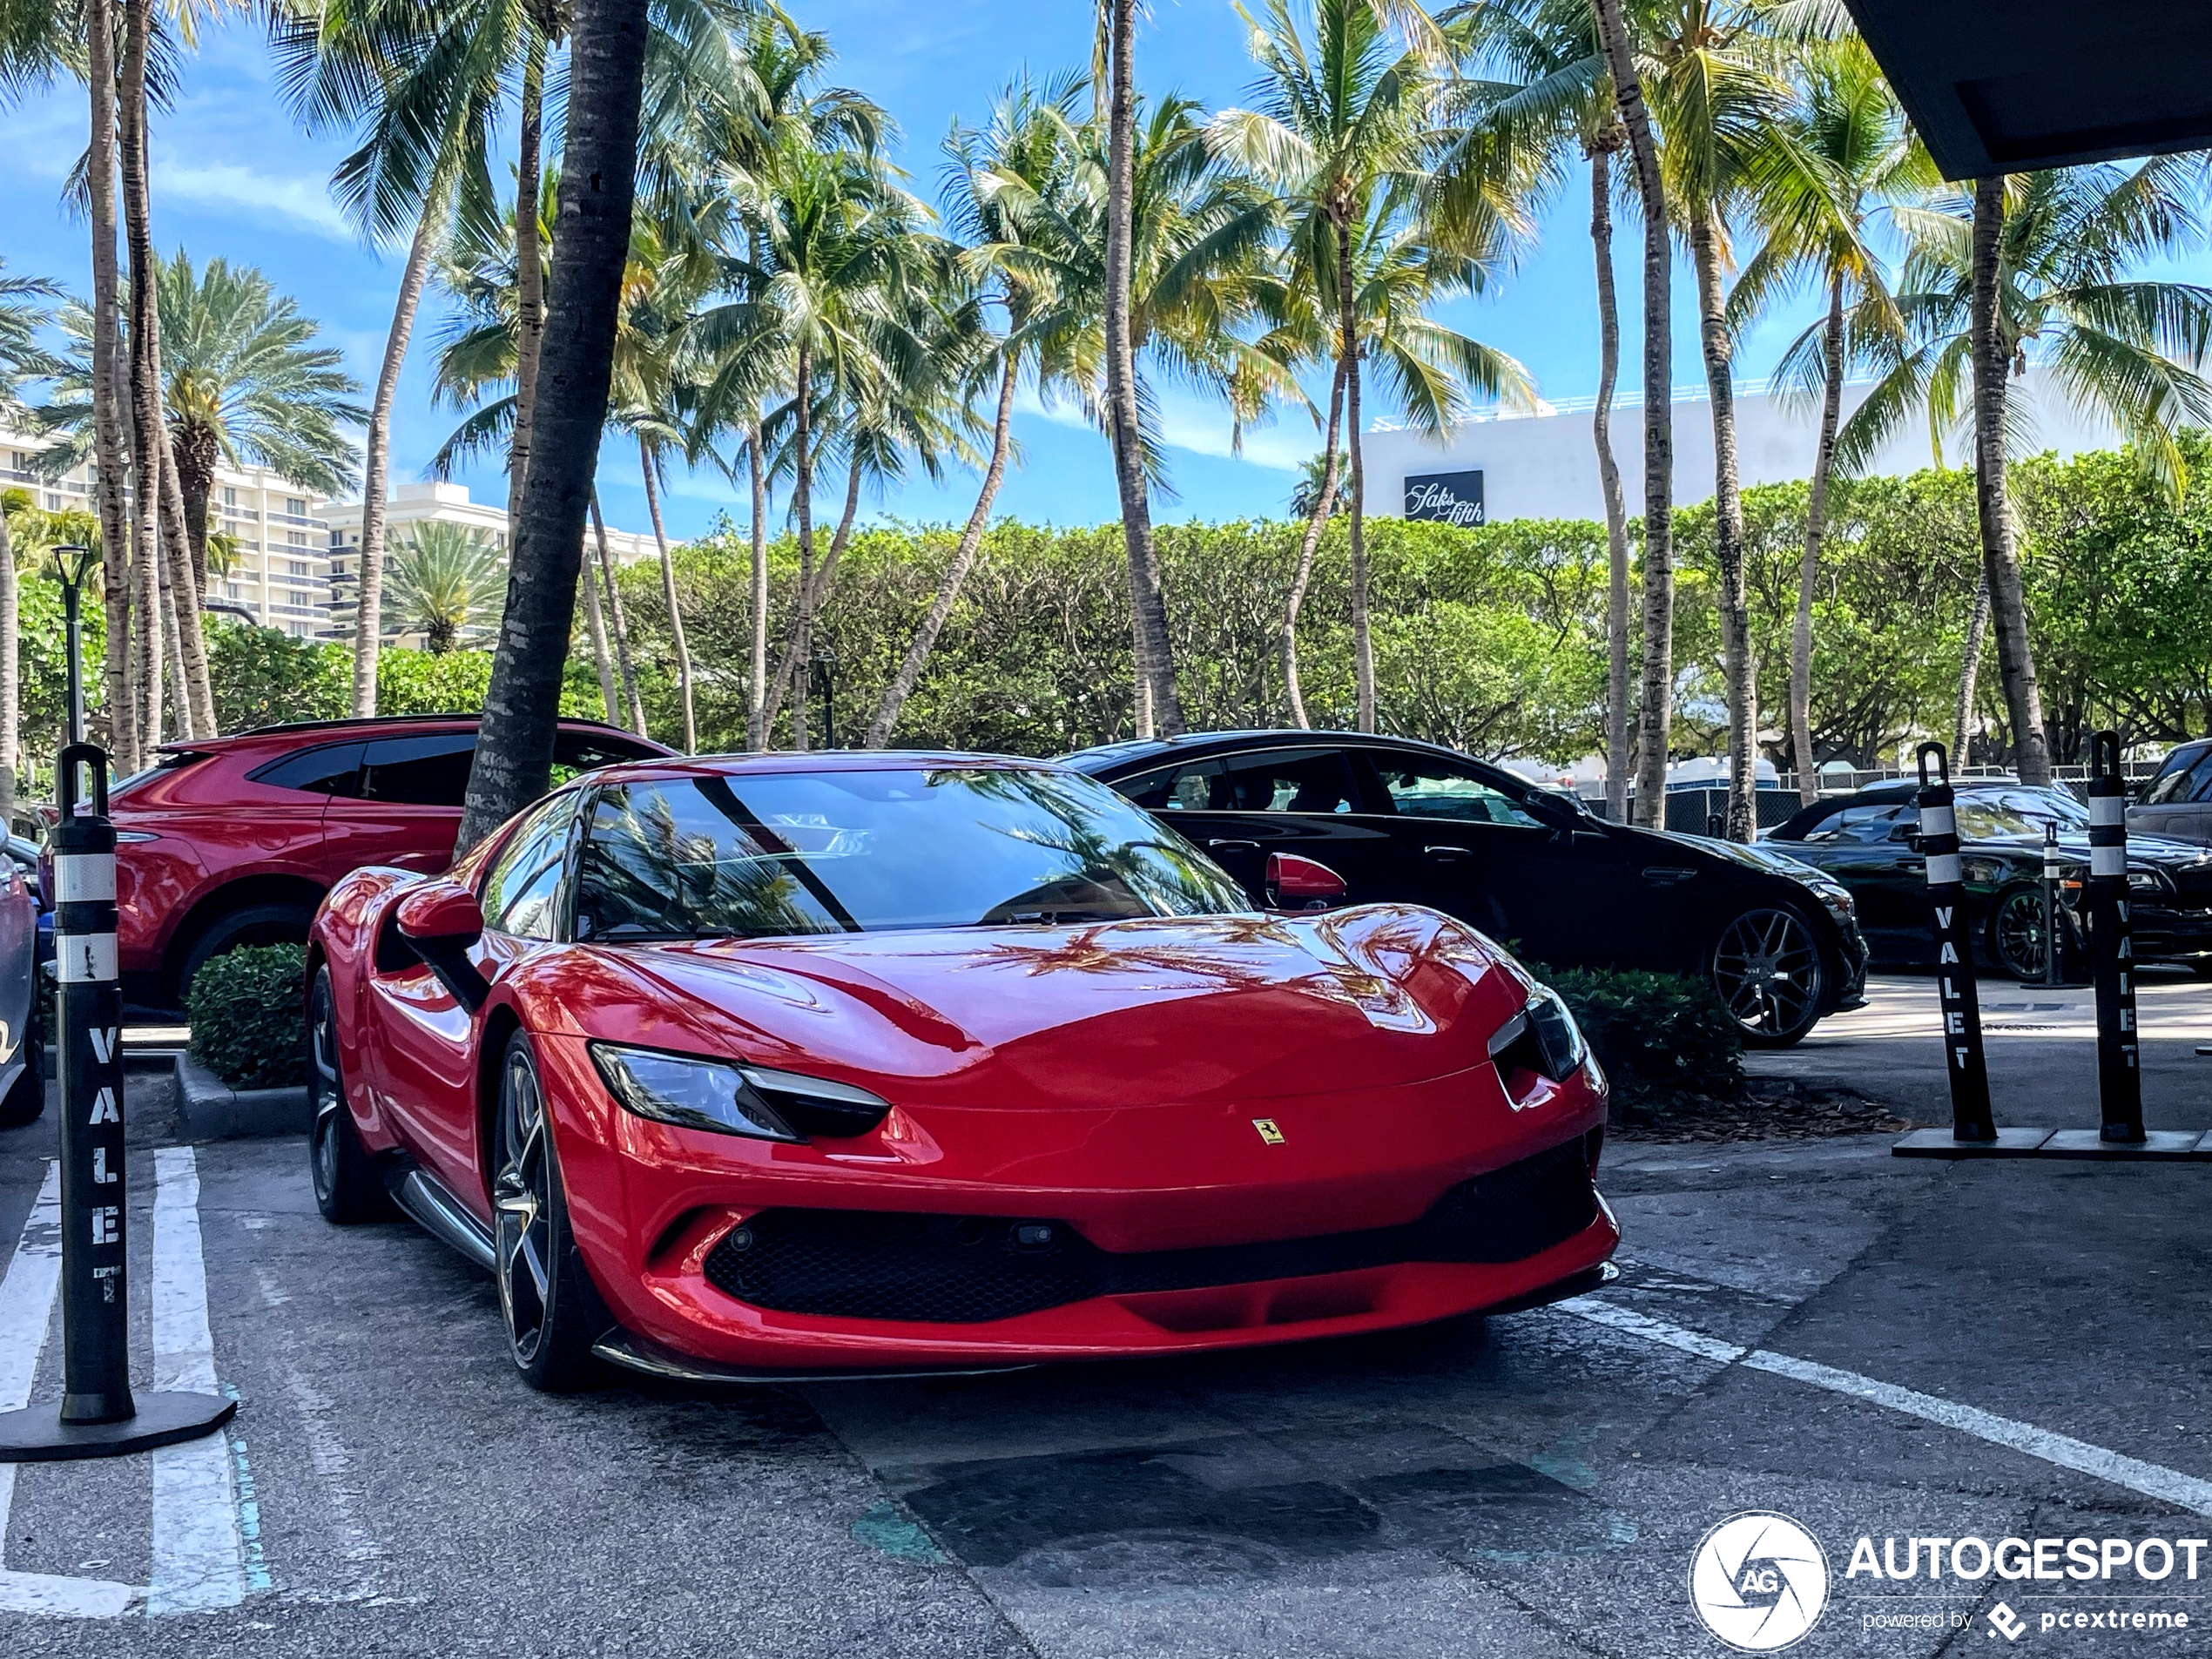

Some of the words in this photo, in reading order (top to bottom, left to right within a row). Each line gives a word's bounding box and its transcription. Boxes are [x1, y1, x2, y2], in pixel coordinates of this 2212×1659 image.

[1405, 482, 1460, 516] Saks
[1935, 907, 1969, 1069] VALET
[2054, 889, 2062, 954] VALET
[2117, 900, 2136, 1067] VALET
[89, 1027, 121, 1304] VALET
